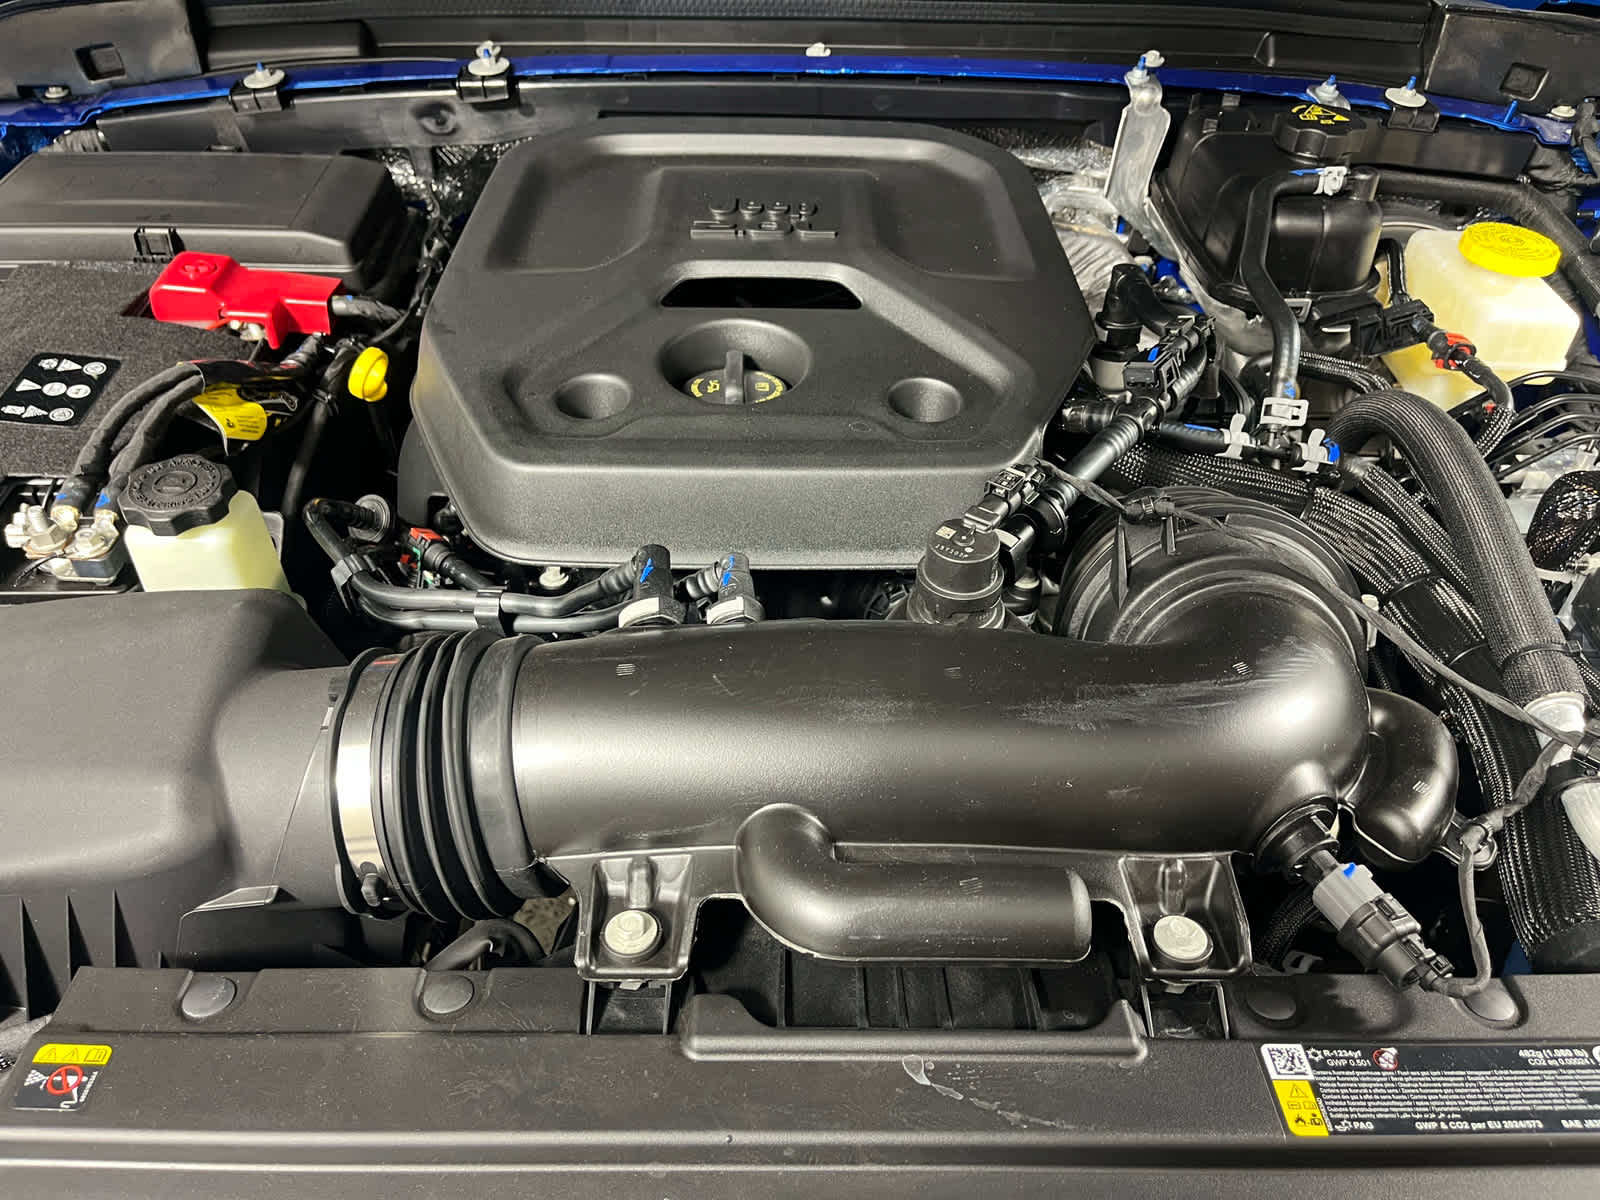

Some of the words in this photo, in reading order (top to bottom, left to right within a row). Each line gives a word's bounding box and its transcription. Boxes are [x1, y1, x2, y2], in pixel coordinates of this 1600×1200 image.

[706, 196, 819, 222] Jeep
[1323, 1049, 1362, 1059] R-1234yf
[1327, 1059, 1347, 1067] GWP
[1349, 1059, 1372, 1067] 0.501
[1528, 1058, 1547, 1066] CO2
[1353, 1121, 1374, 1130] PAG
[1415, 1121, 1437, 1130] GWP
[1449, 1121, 1470, 1130] CO2
[1487, 1120, 1502, 1129] EU
